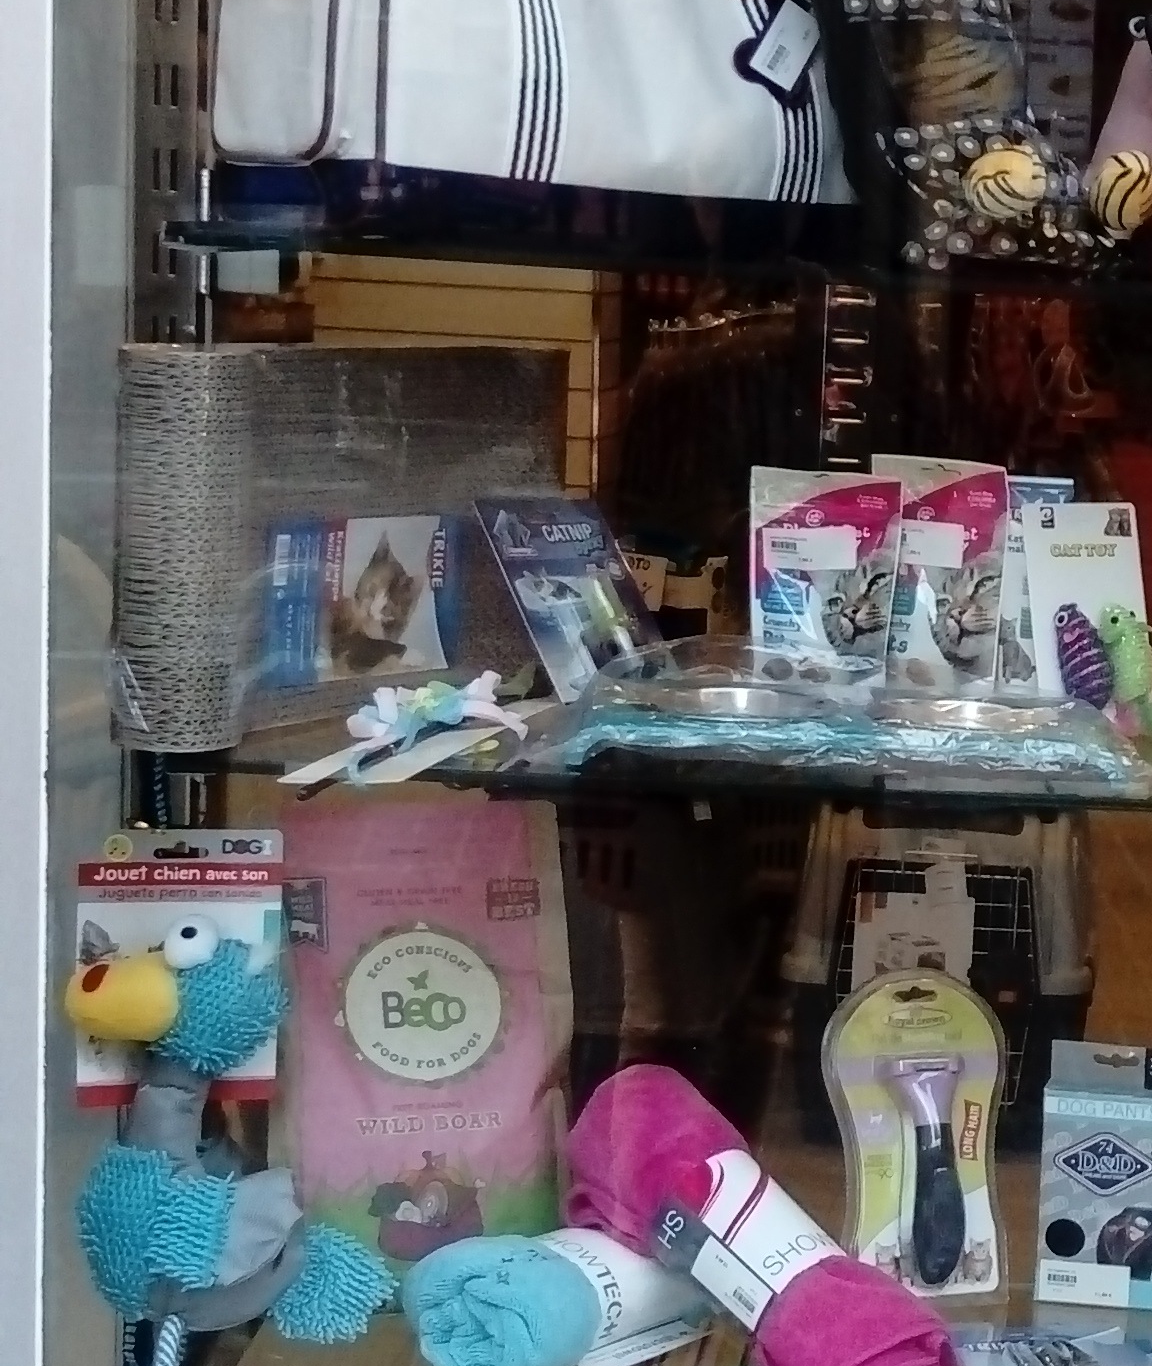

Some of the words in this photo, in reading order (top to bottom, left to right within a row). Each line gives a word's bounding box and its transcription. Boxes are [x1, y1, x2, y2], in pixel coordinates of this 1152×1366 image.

[542, 523, 592, 542] CATNIP
[432, 528, 446, 589] TRIXIE
[1050, 543, 1082, 558] CAT
[1086, 543, 1118, 558] TOY
[93, 865, 149, 882] Jouet
[153, 865, 201, 882] chien
[205, 870, 238, 882] avec
[242, 869, 269, 882] son
[366, 955, 392, 980] ECO
[395, 945, 474, 974] CONSCIOUS
[371, 1041, 410, 1067] FOOD
[416, 1057, 446, 1069] FOR
[450, 1032, 482, 1062] DOGS
[966, 1104, 981, 1131] HAIR
[1057, 1098, 1097, 1116] DOG
[356, 1115, 424, 1136] WILD
[433, 1110, 502, 1132] BOAR
[962, 1129, 978, 1160] LONG
[1077, 1149, 1136, 1176] D&D
